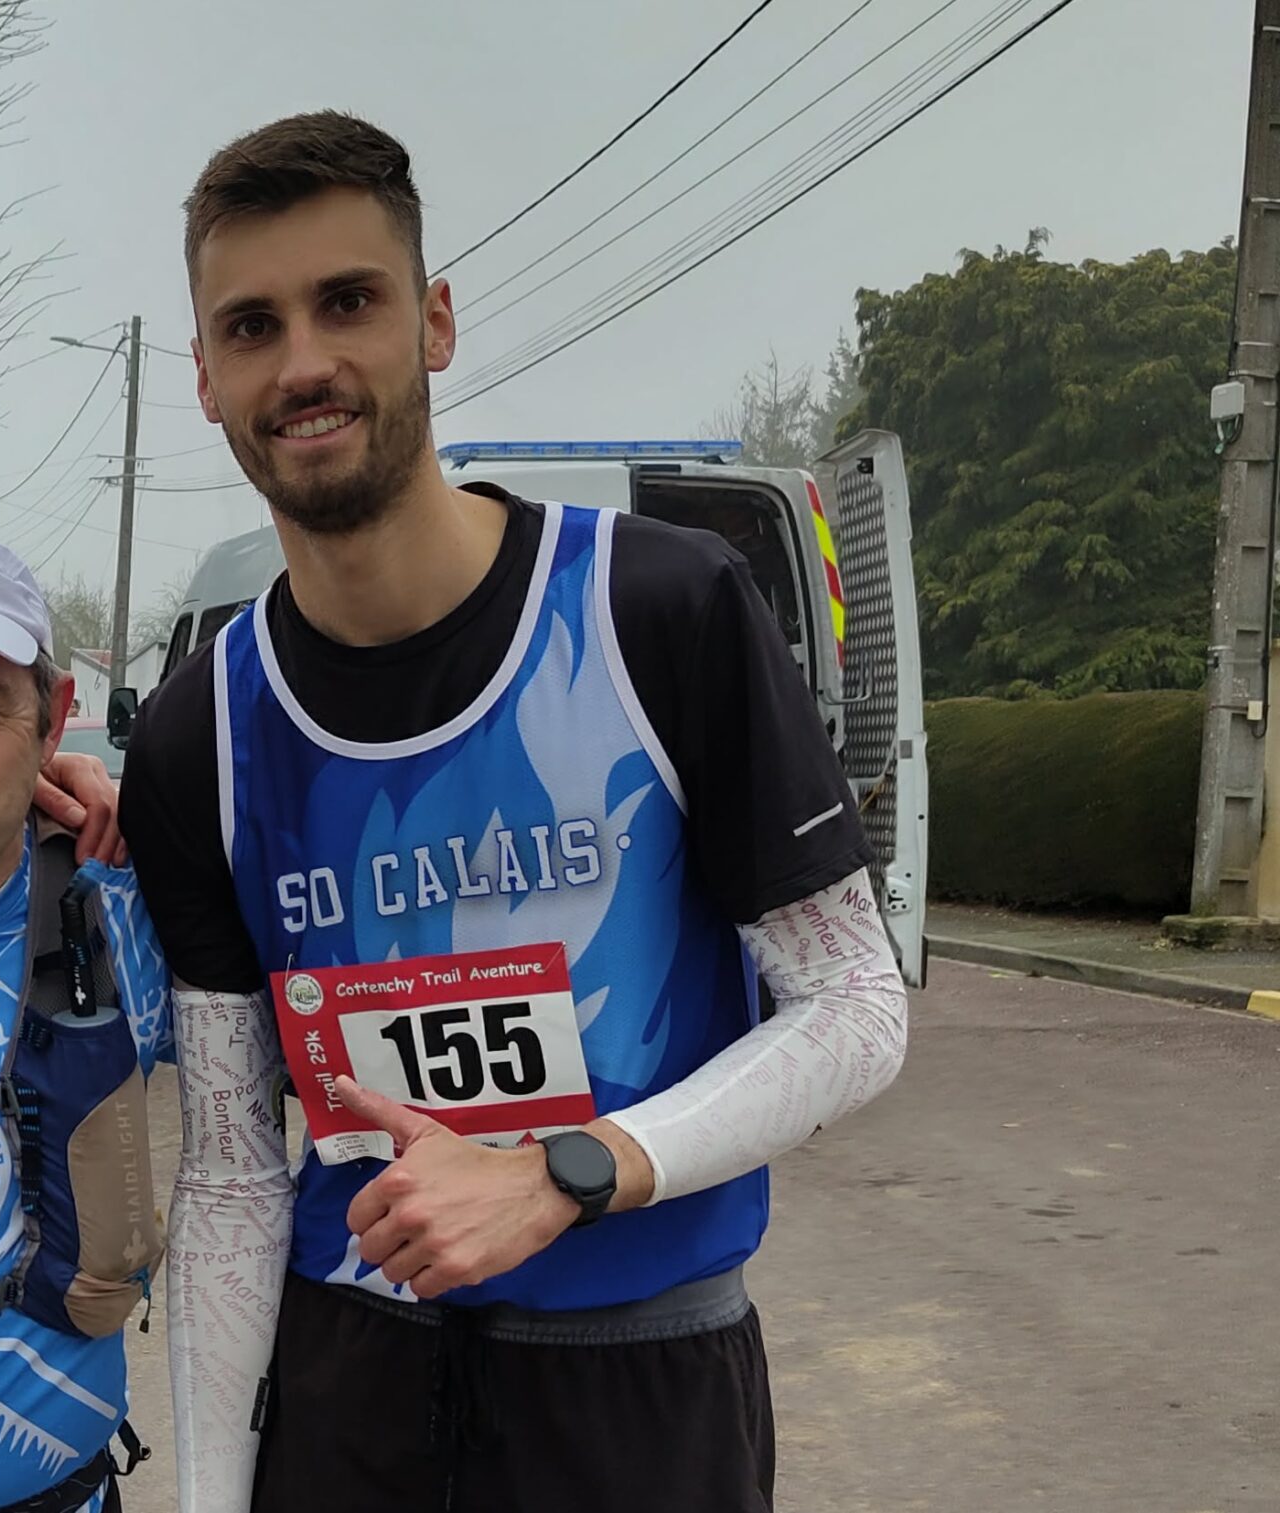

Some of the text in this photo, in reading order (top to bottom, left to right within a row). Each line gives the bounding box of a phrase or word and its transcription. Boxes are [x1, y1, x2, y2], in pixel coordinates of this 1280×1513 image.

[276, 817, 601, 934] SO CALAIS
[336, 977, 415, 998] Cottenchy
[420, 967, 461, 986] Trail
[469, 962, 543, 981] Aventure
[228, 1005, 249, 1049] Trail
[304, 1029, 327, 1066] 29k
[380, 1002, 547, 1101] 155
[315, 1072, 343, 1113] Trail
[212, 1089, 237, 1166] Bonheur
